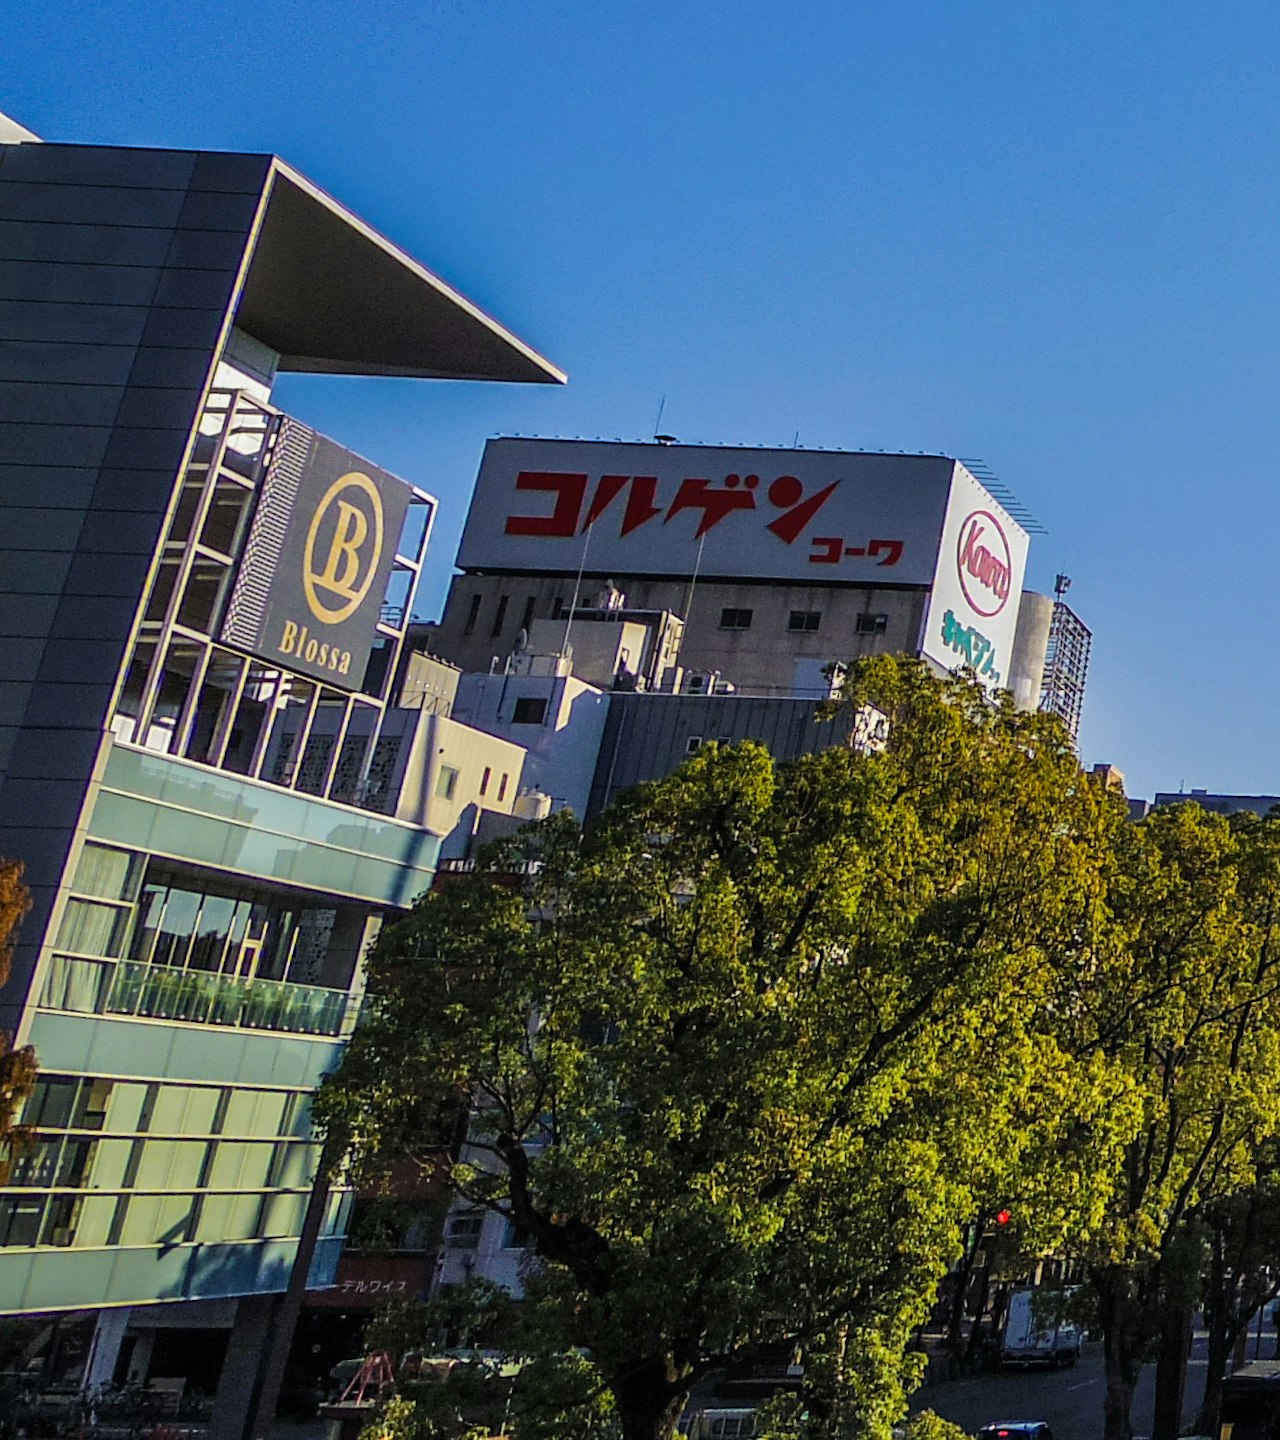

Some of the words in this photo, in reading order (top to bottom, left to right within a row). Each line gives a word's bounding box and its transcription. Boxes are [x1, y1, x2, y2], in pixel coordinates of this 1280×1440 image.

[504, 471, 842, 544] コルゲン
[808, 537, 905, 566] コーワ
[278, 620, 352, 675] Blossa
